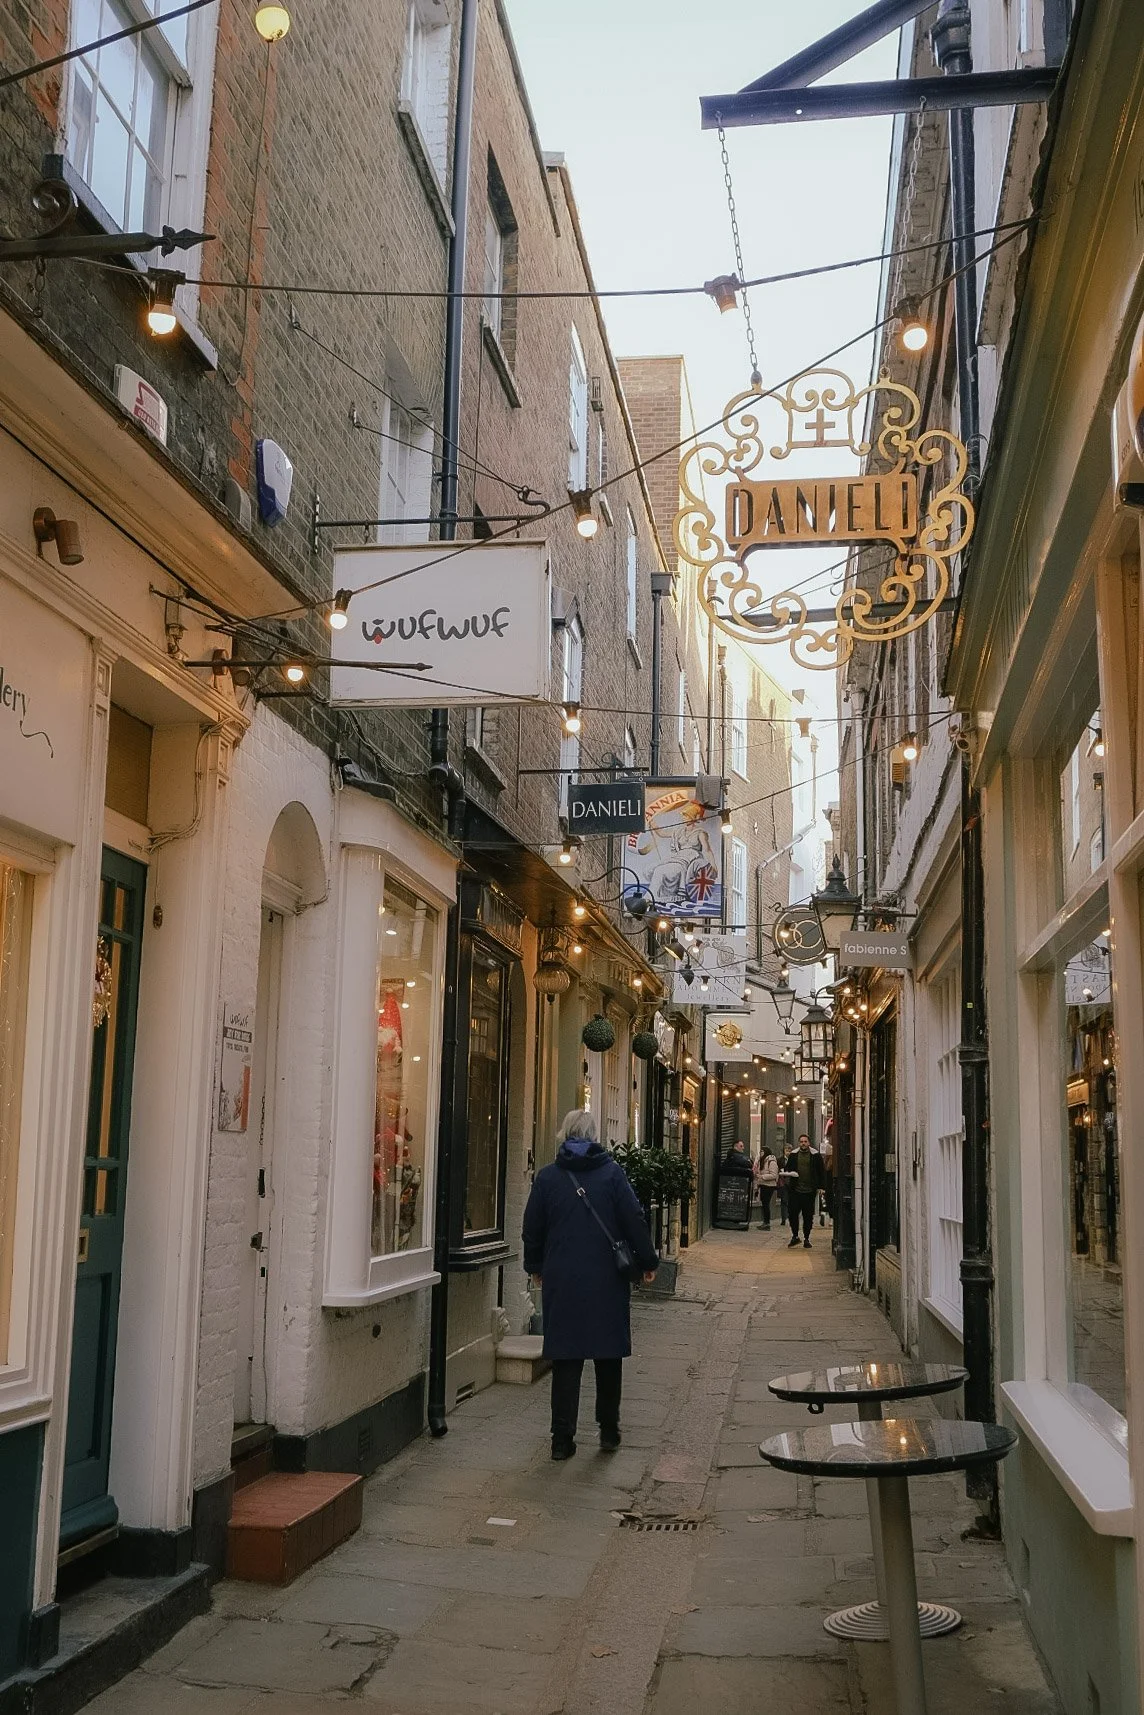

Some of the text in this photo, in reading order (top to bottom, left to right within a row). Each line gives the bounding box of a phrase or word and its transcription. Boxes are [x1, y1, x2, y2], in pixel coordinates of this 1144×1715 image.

[733, 482, 909, 538] DANIELI
[572, 799, 641, 819] DANIELI
[844, 943, 898, 955] fabienne
